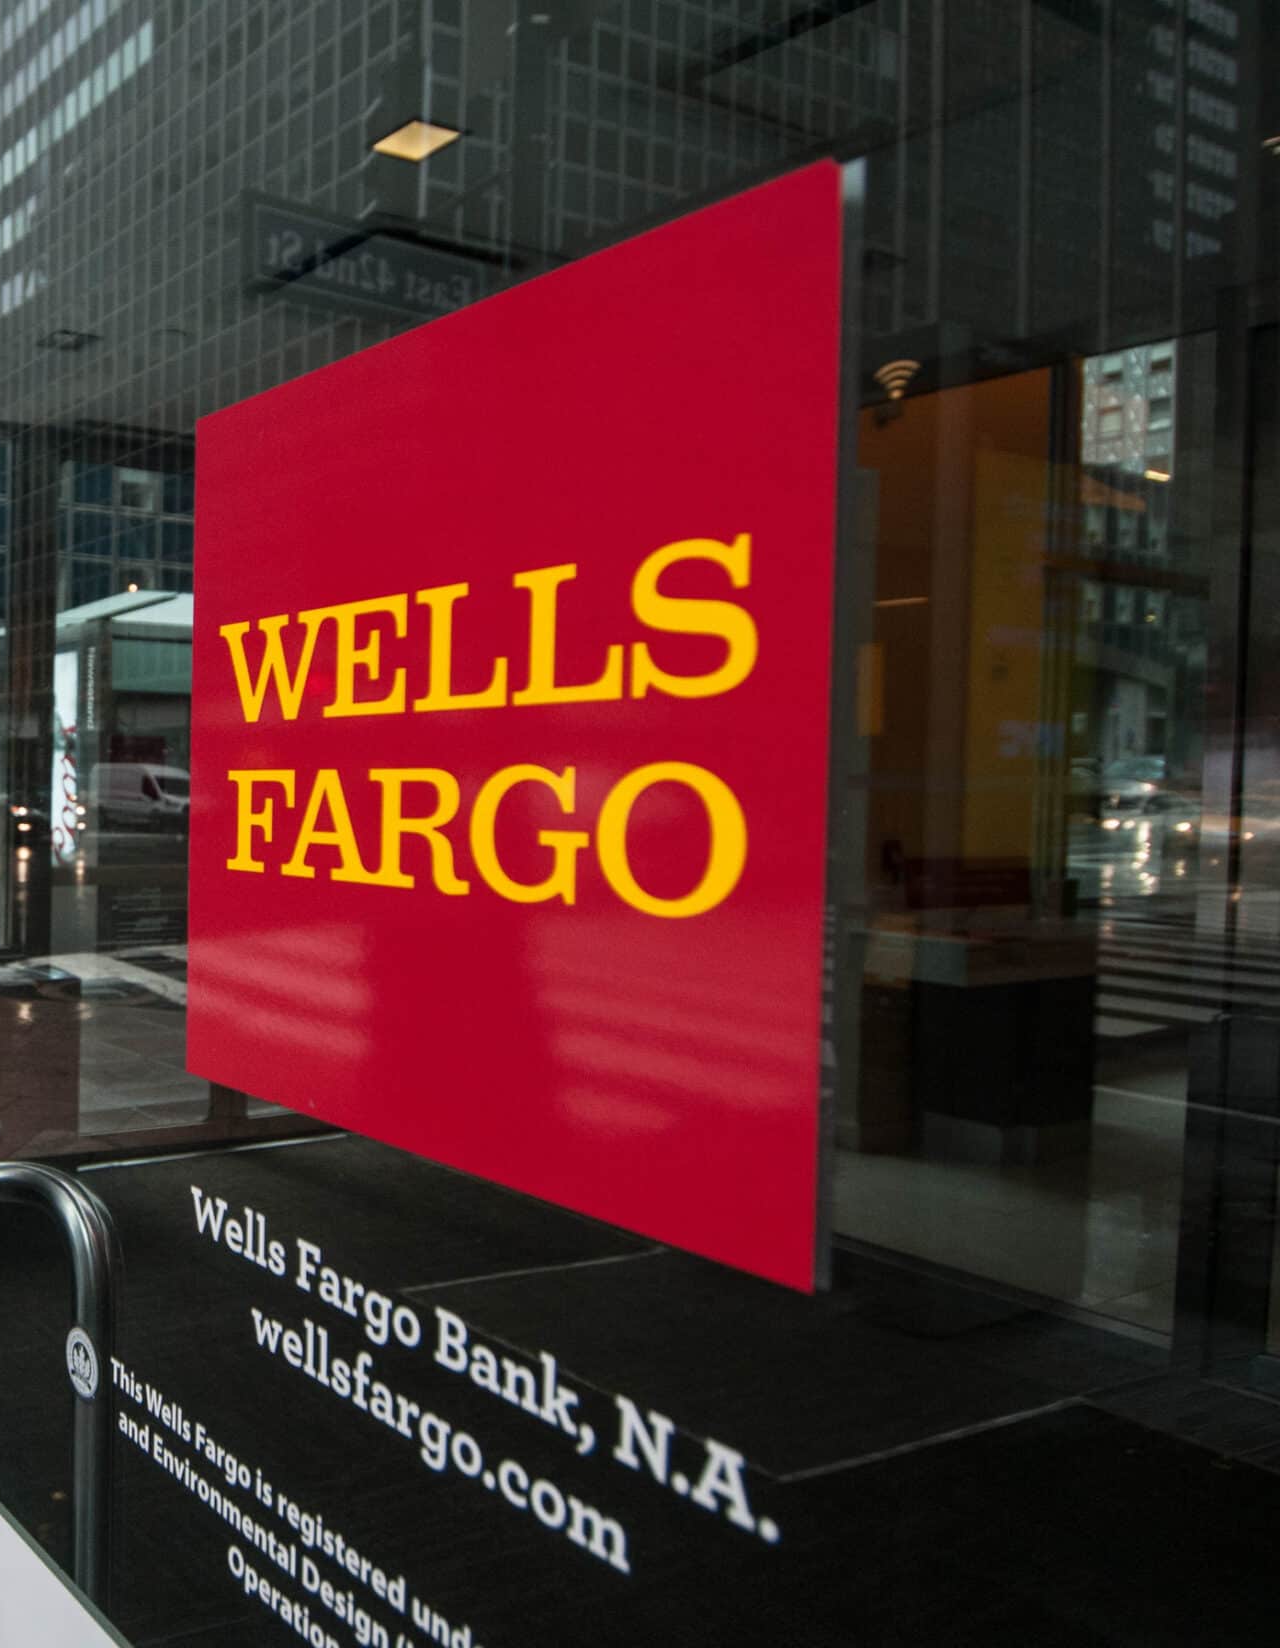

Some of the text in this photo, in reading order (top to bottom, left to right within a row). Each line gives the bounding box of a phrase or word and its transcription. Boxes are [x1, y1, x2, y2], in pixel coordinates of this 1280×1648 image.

[219, 532, 759, 724] WELLS
[226, 761, 748, 919] FARGO
[190, 1184, 781, 1543] Wells Fargo Bank, N.A.
[250, 1306, 631, 1574] wellsfargo.com
[110, 1356, 143, 1404] This
[145, 1383, 193, 1443] Wells
[195, 1422, 252, 1490] Fargo
[255, 1467, 273, 1508] is
[277, 1492, 407, 1614] registered
[412, 1596, 482, 1648] und
[118, 1410, 390, 1648] and Environmental Design
